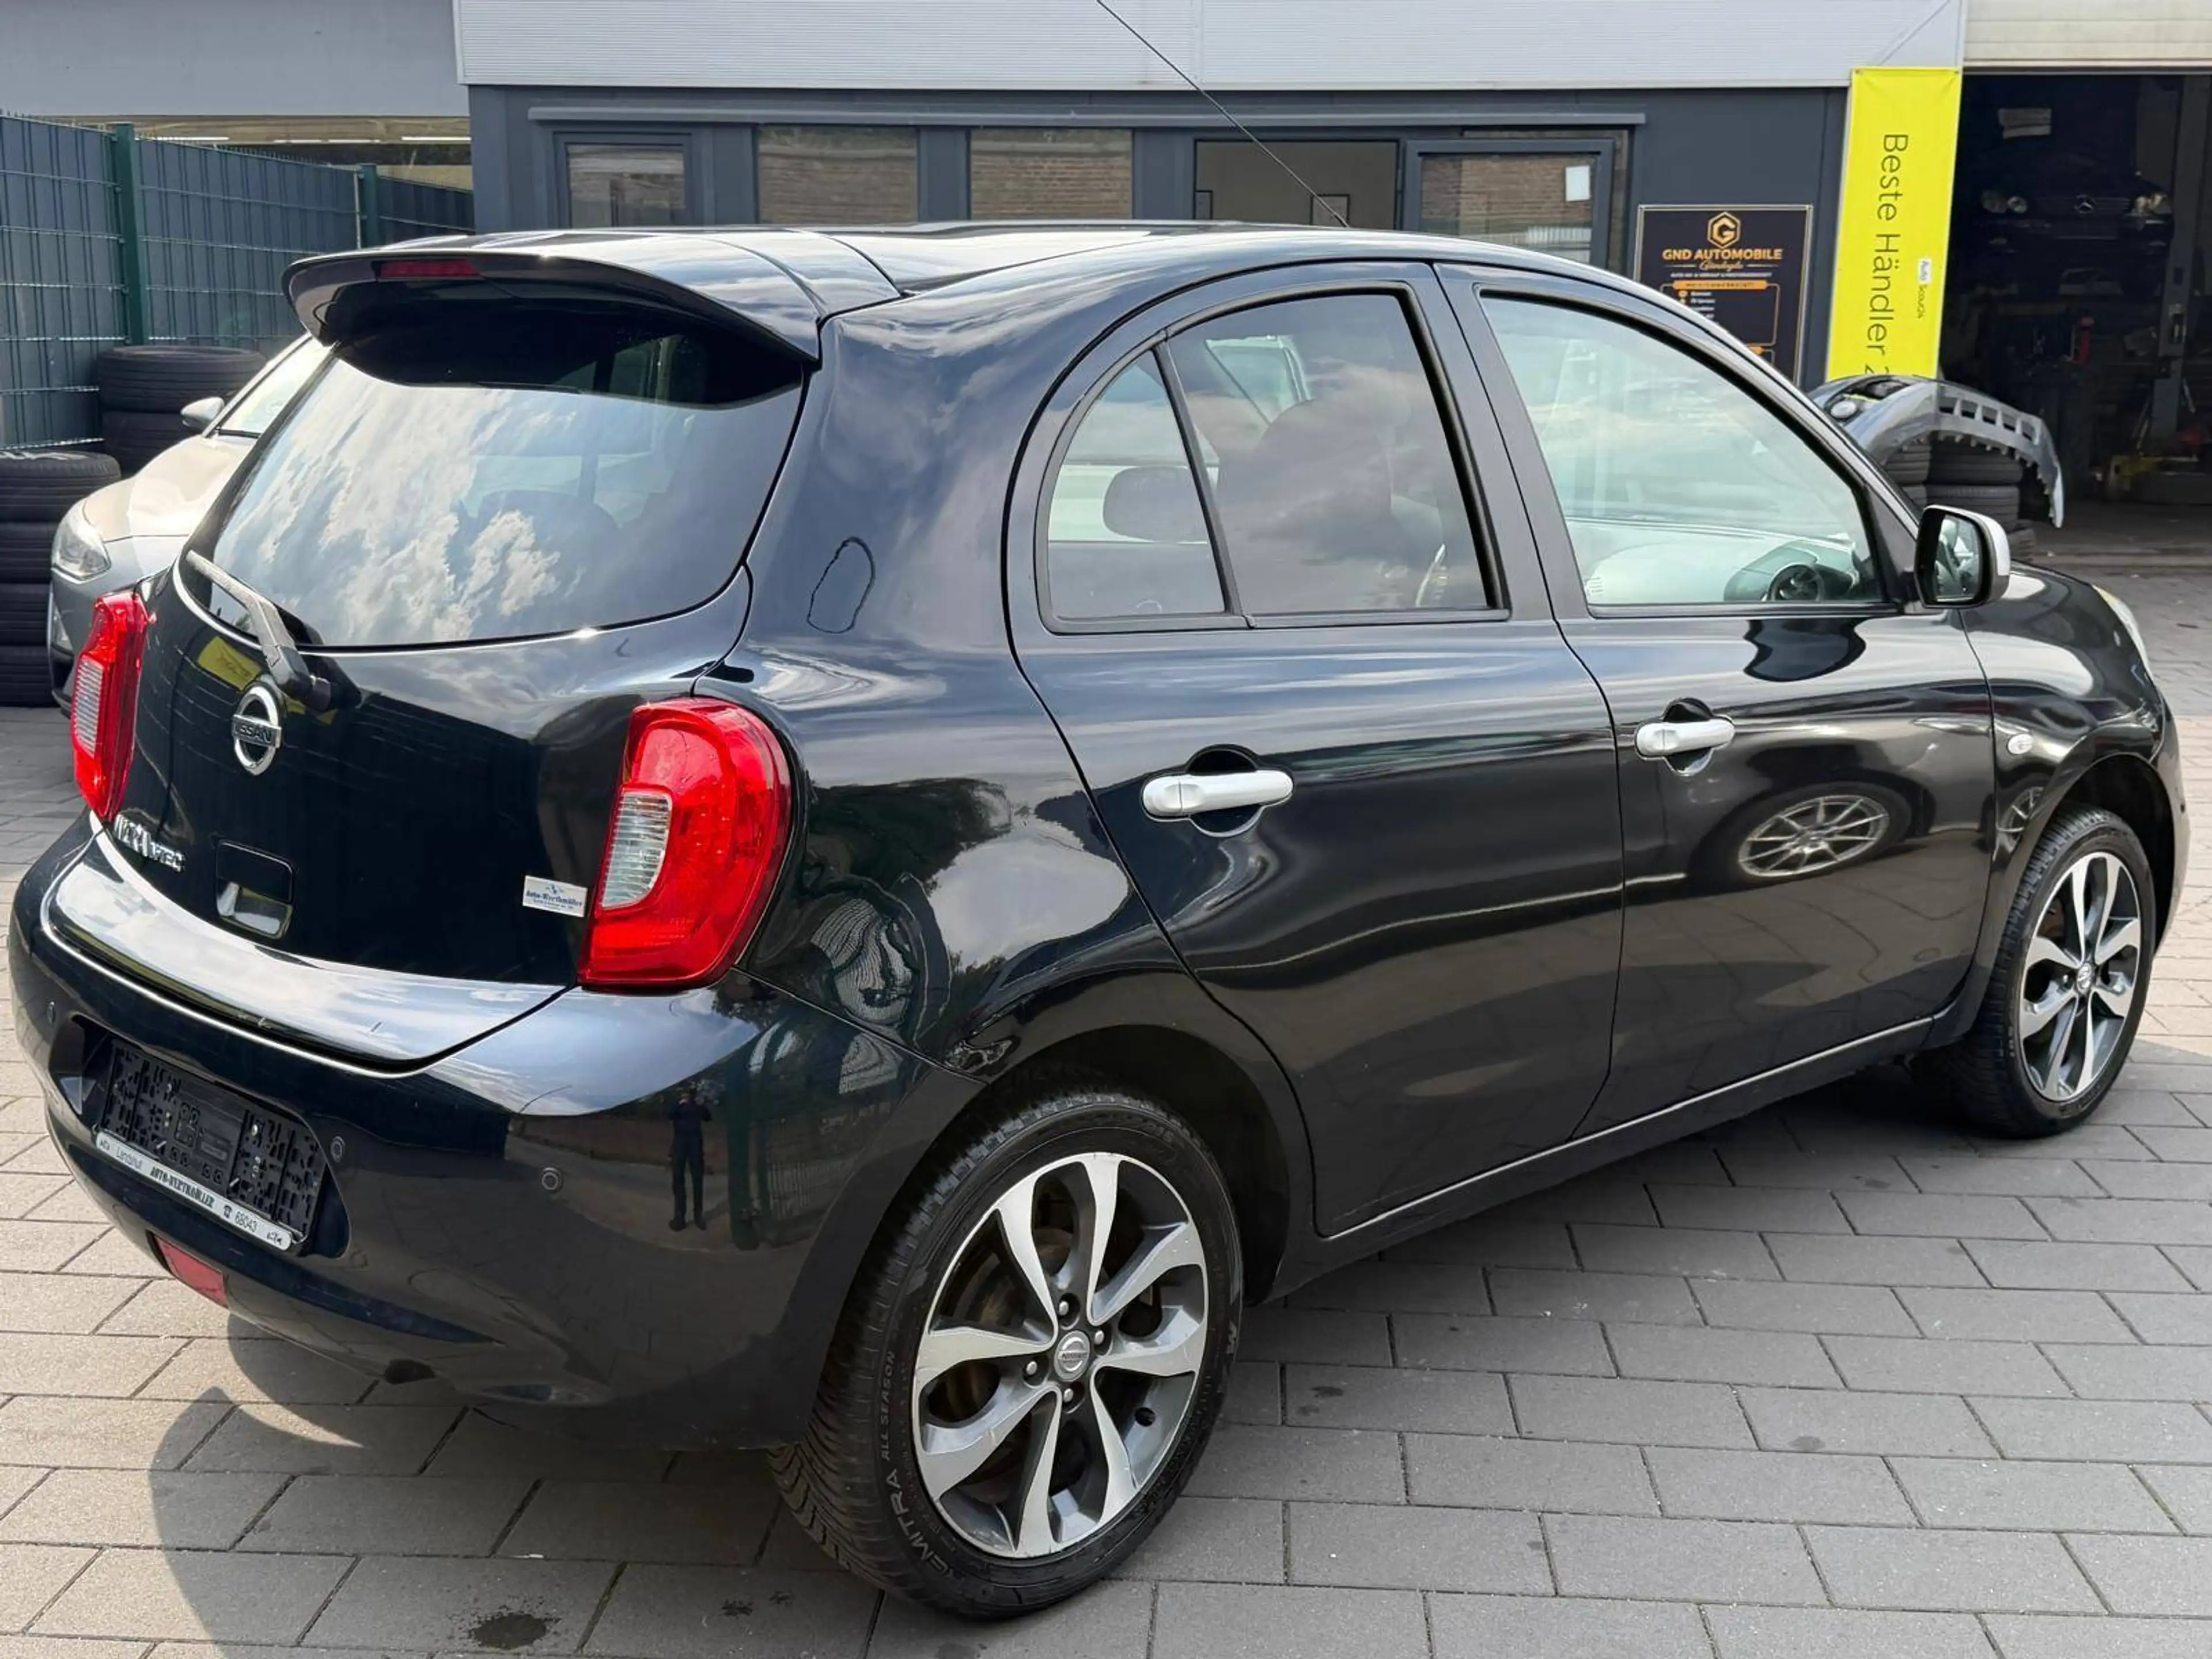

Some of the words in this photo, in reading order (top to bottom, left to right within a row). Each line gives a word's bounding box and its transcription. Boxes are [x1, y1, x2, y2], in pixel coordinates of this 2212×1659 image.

[1876, 134, 1908, 222] Beste
[1662, 248, 1692, 260] GND
[1694, 248, 1783, 260] AUTOMOBILE
[1866, 234, 1901, 355] Händler
[880, 1427, 891, 1461] ALL
